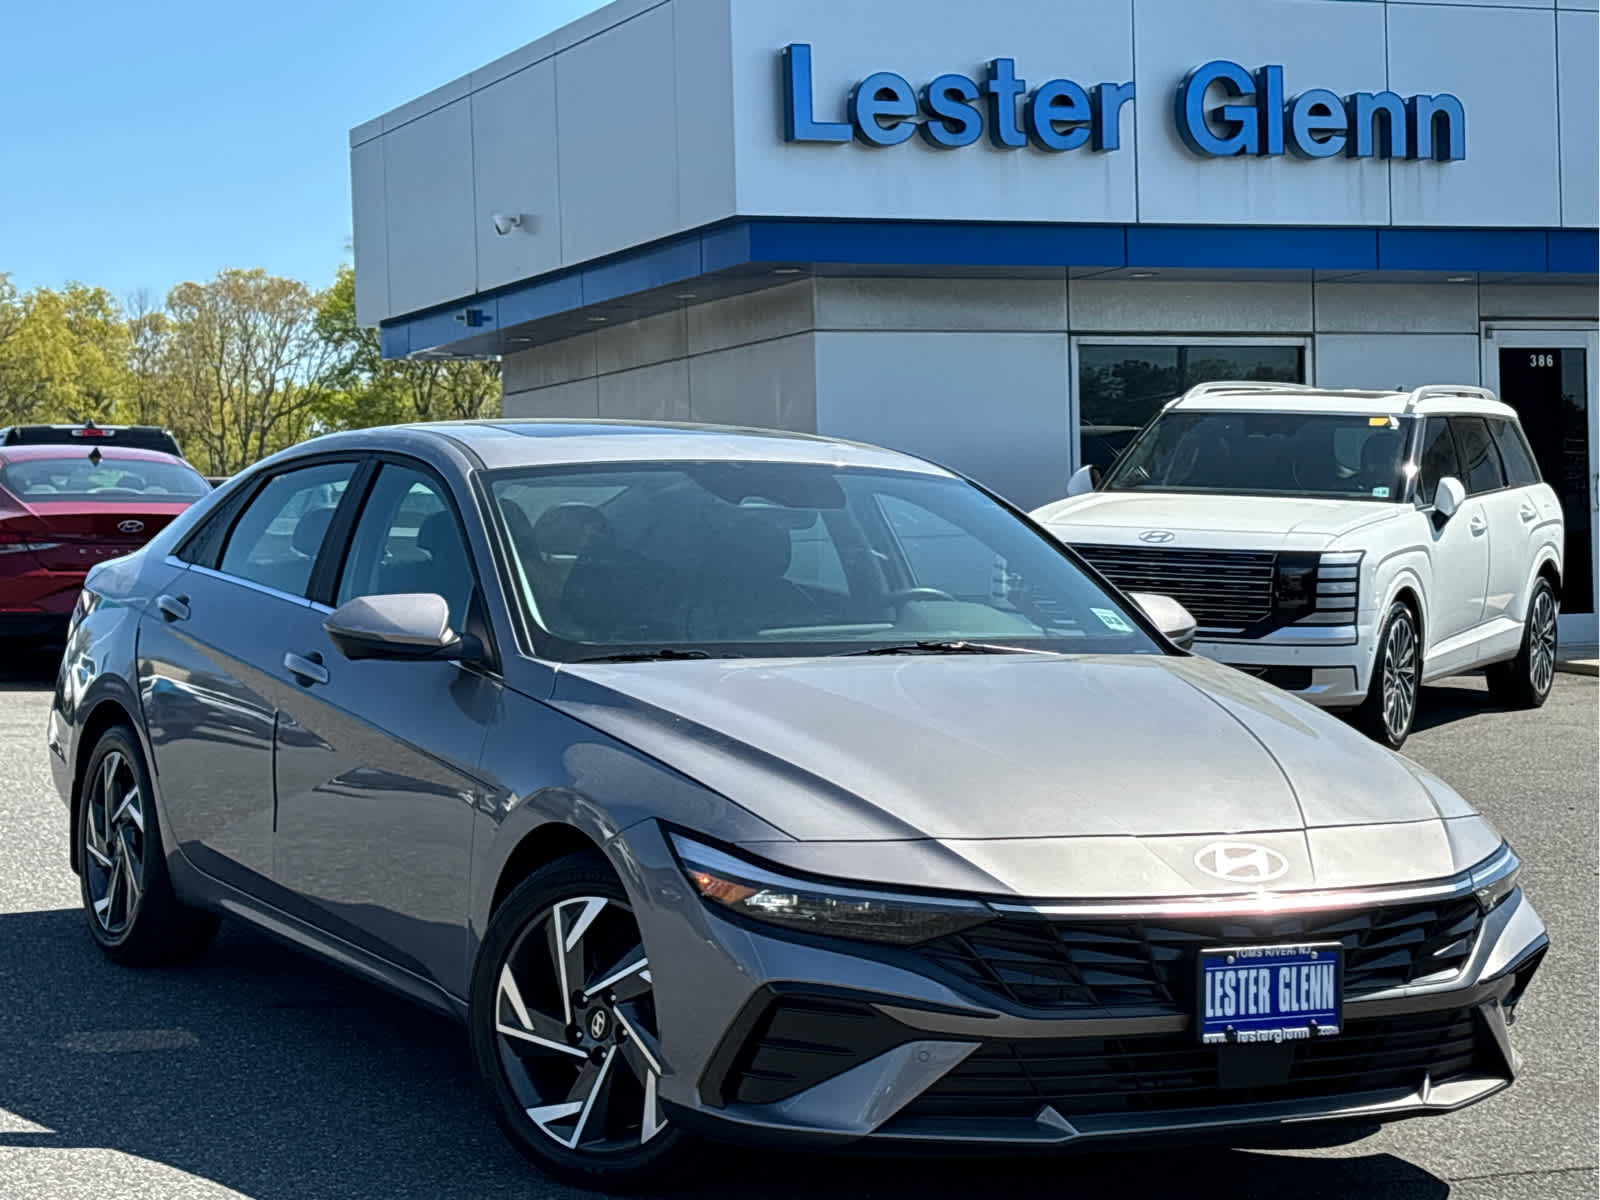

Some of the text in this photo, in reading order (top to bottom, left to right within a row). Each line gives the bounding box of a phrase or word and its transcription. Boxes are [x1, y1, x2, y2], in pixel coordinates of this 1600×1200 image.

[782, 43, 1466, 161] Lester Glenn
[1529, 354, 1553, 367] 386
[1298, 946, 1311, 955] NJ
[1205, 964, 1335, 1018] LESTER GLENN
